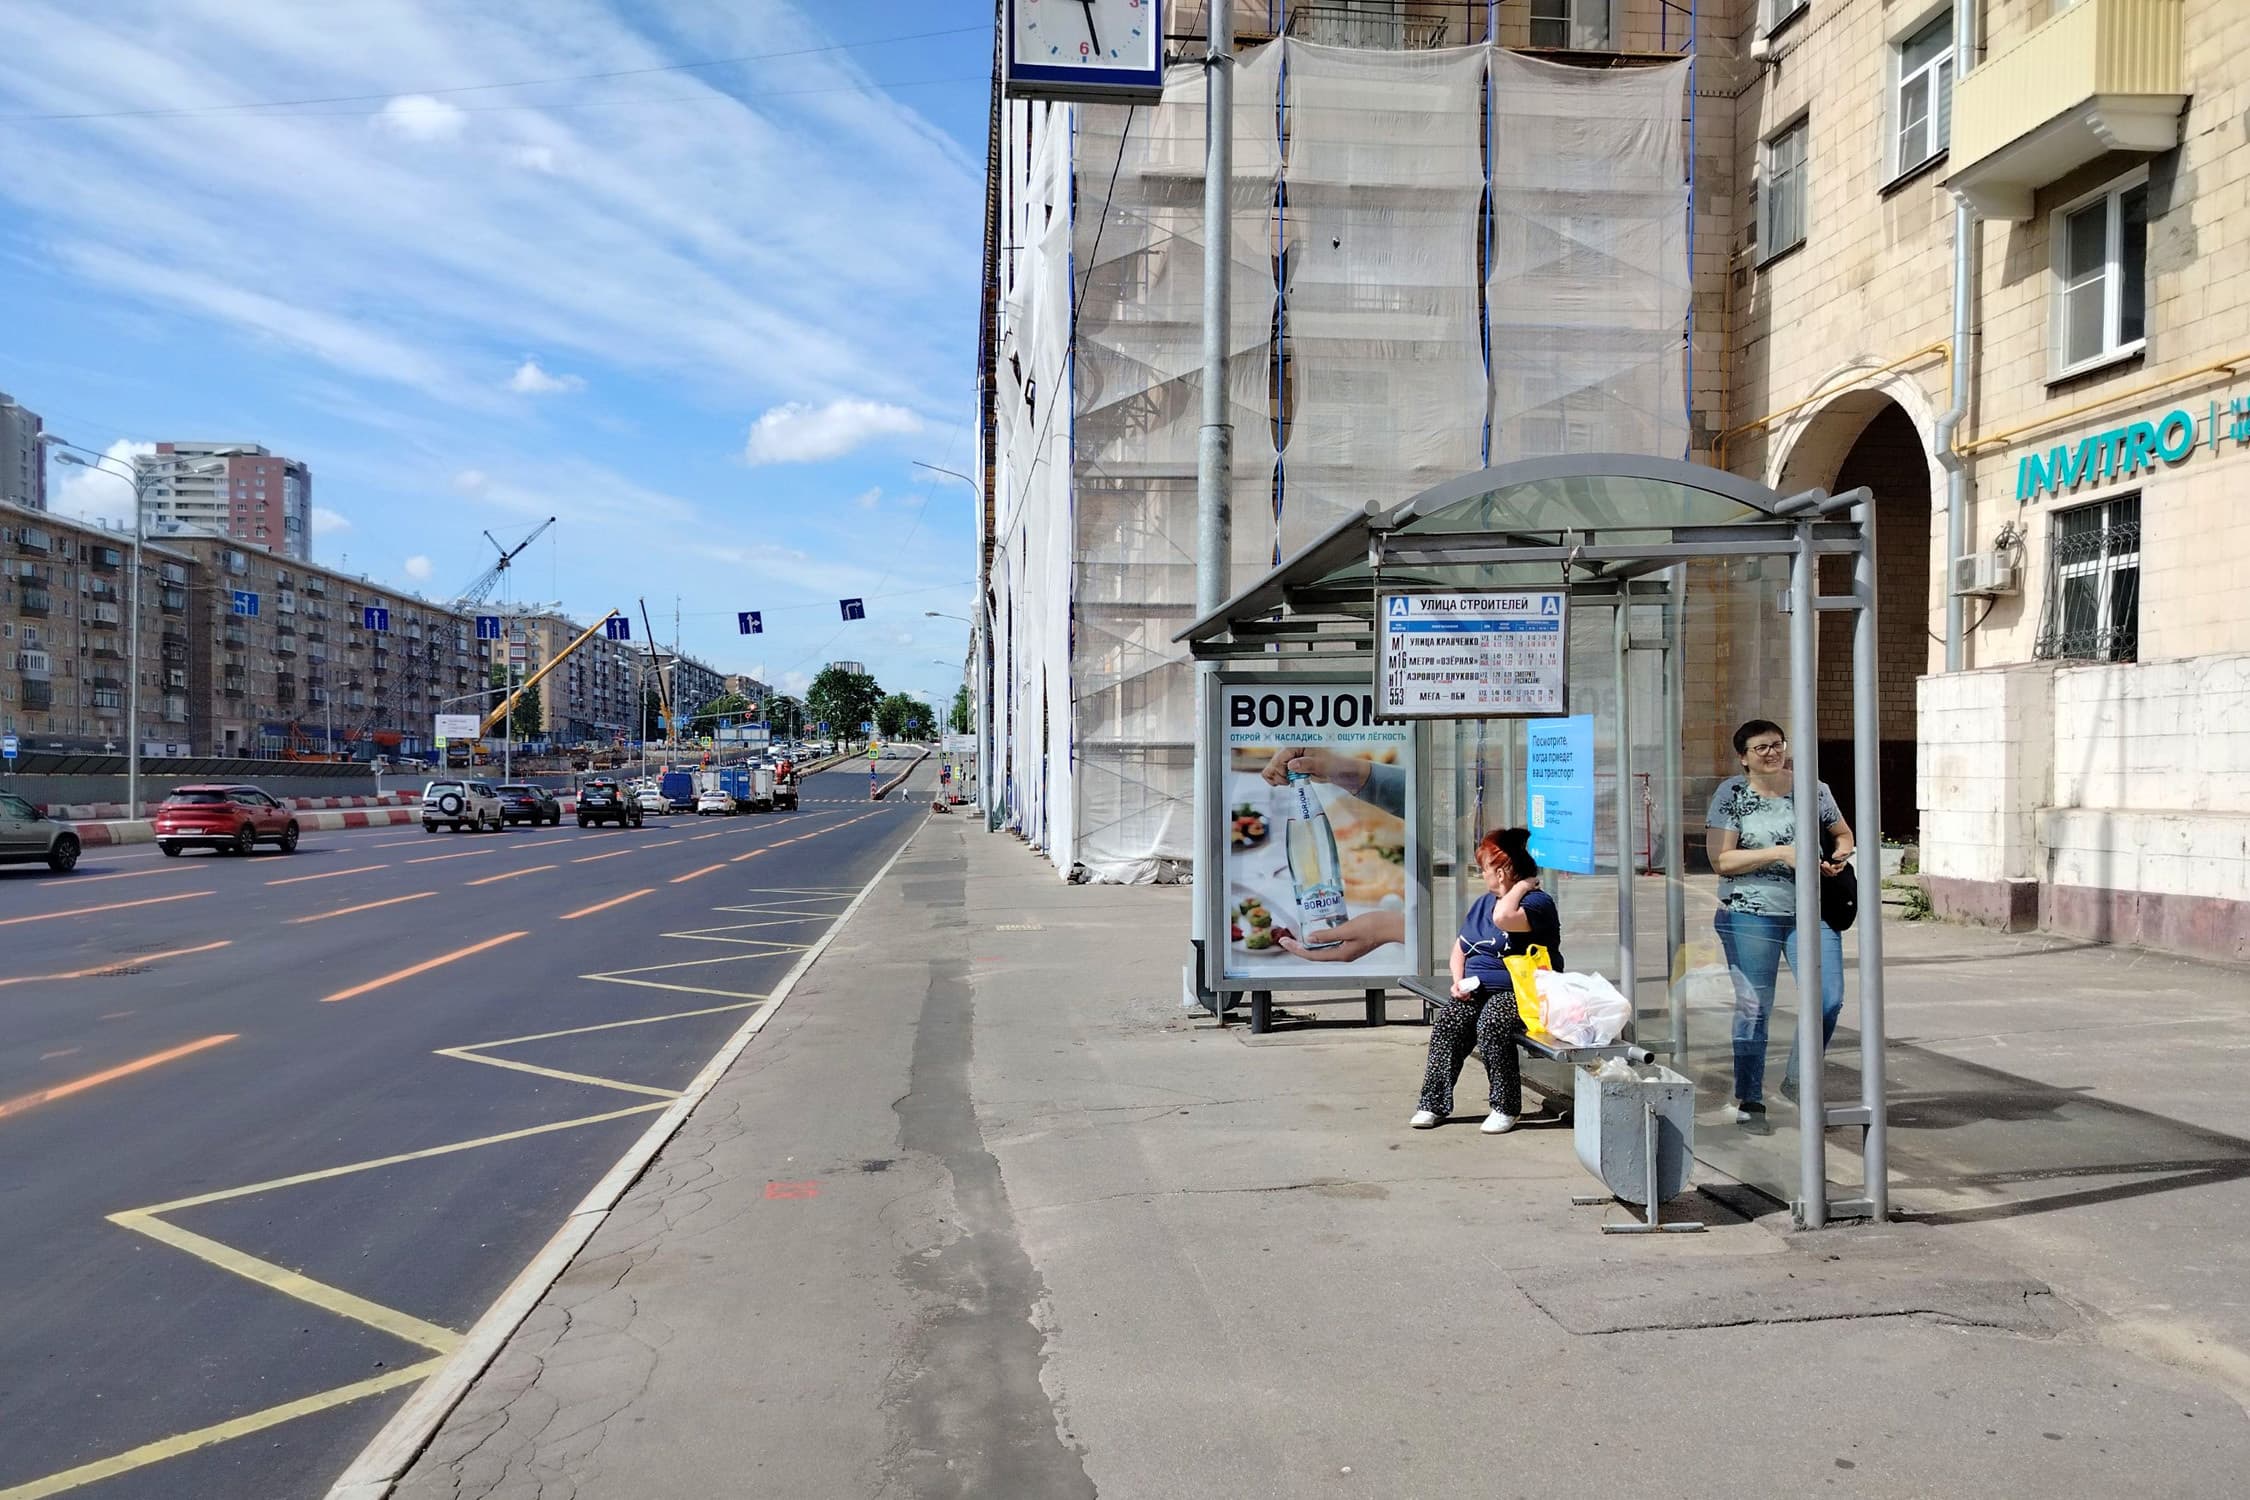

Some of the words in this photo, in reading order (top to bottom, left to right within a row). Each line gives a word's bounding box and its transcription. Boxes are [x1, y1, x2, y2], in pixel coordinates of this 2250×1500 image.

[1080, 42, 1089, 55] 6
[2016, 409, 2198, 500] INVITRO
[1421, 600, 1457, 612] УЛИЦА
[1461, 597, 1528, 611] СТРОИТЕЛЕЙ
[1410, 637, 1434, 647] УЛИЦА
[1436, 637, 1479, 646] КРАВЧЕНКО
[1409, 657, 1435, 665] МЕТРО
[1407, 672, 1444, 681] АЭРОПОРТ
[1389, 688, 1404, 705] 553
[1420, 692, 1440, 700] МЕГА
[1230, 732, 1261, 742] ОТКРОЙ
[1275, 733, 1323, 742] НАСЛАДИСЬ
[1337, 733, 1365, 742] ОЩУТИ
